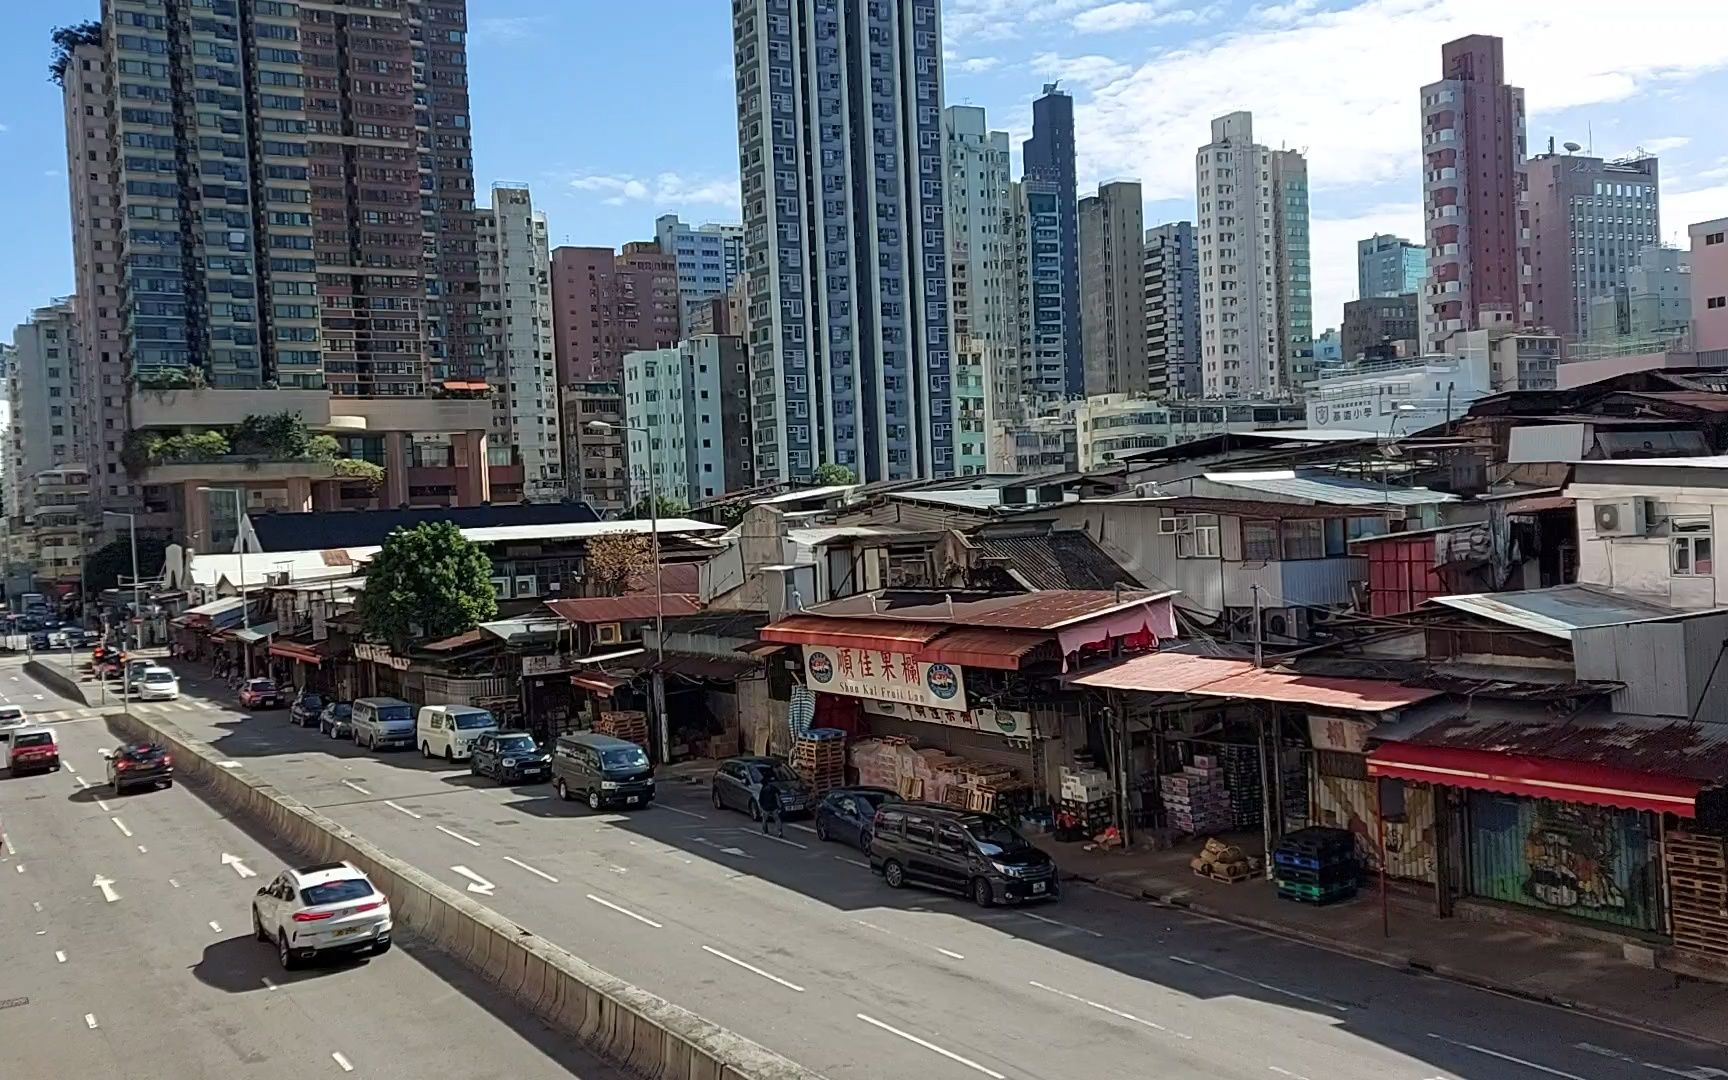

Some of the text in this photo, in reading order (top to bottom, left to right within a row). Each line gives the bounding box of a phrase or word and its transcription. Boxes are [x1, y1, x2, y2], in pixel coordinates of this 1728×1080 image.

[836, 649, 921, 686] 順佳果欄
[839, 681, 859, 694] Shun
[881, 687, 904, 701] Fruit
[907, 690, 925, 703] Lan
